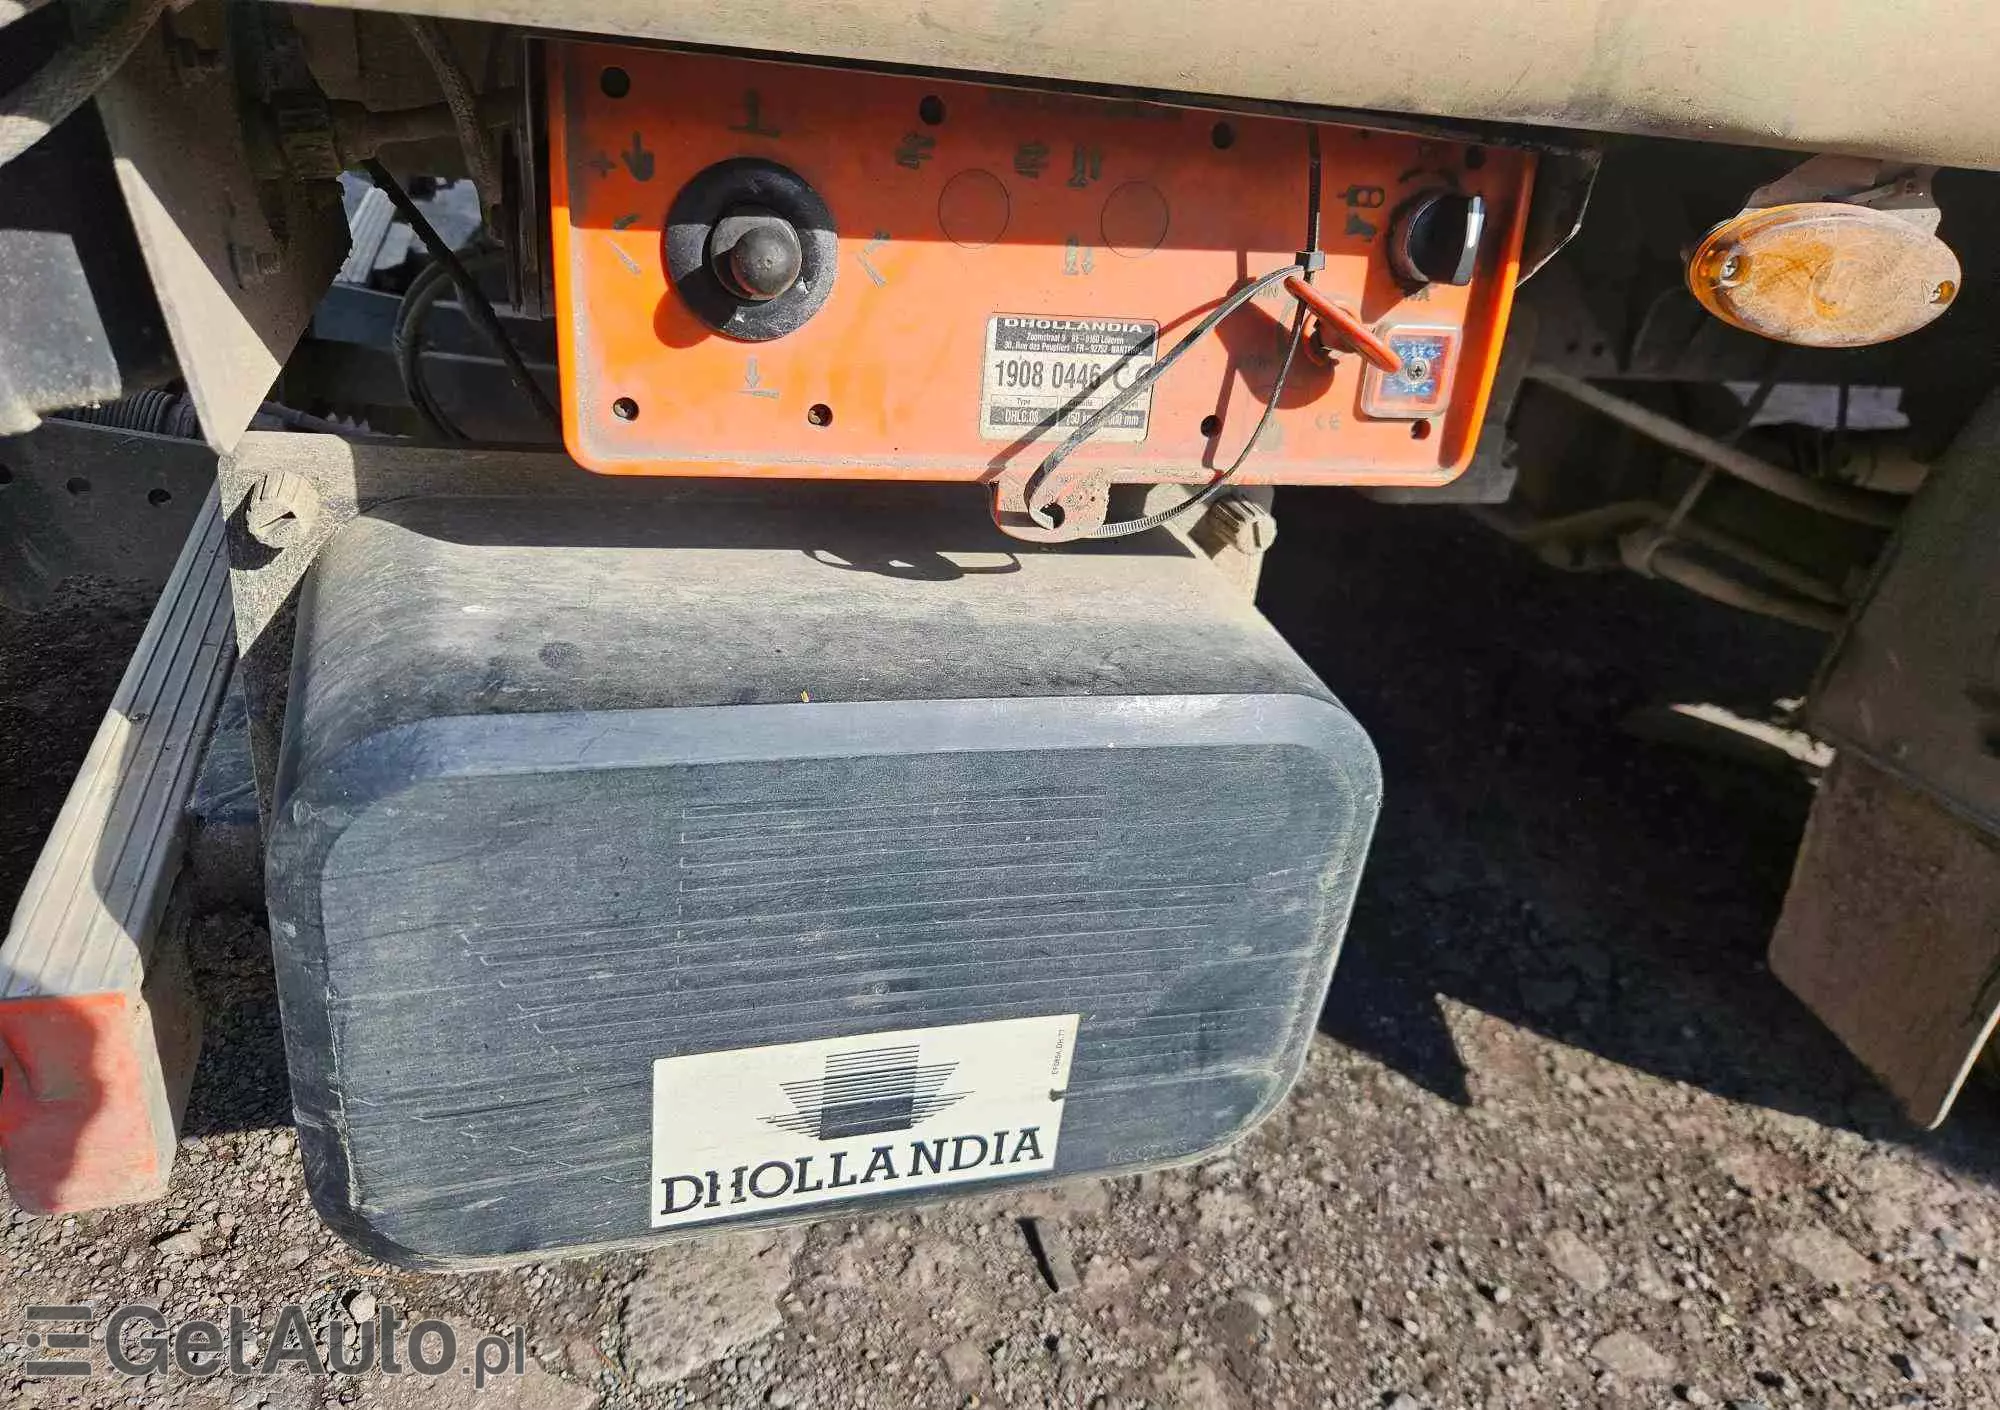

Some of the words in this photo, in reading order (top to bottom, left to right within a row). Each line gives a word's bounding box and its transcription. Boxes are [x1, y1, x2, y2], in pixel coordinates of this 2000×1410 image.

[1004, 319, 1143, 333] DHOLLANDIA
[995, 359, 1044, 388] 1908
[1052, 361, 1101, 390] 0446
[1016, 399, 1031, 411] Type
[660, 1126, 1044, 1216] DHOLLANDIA
